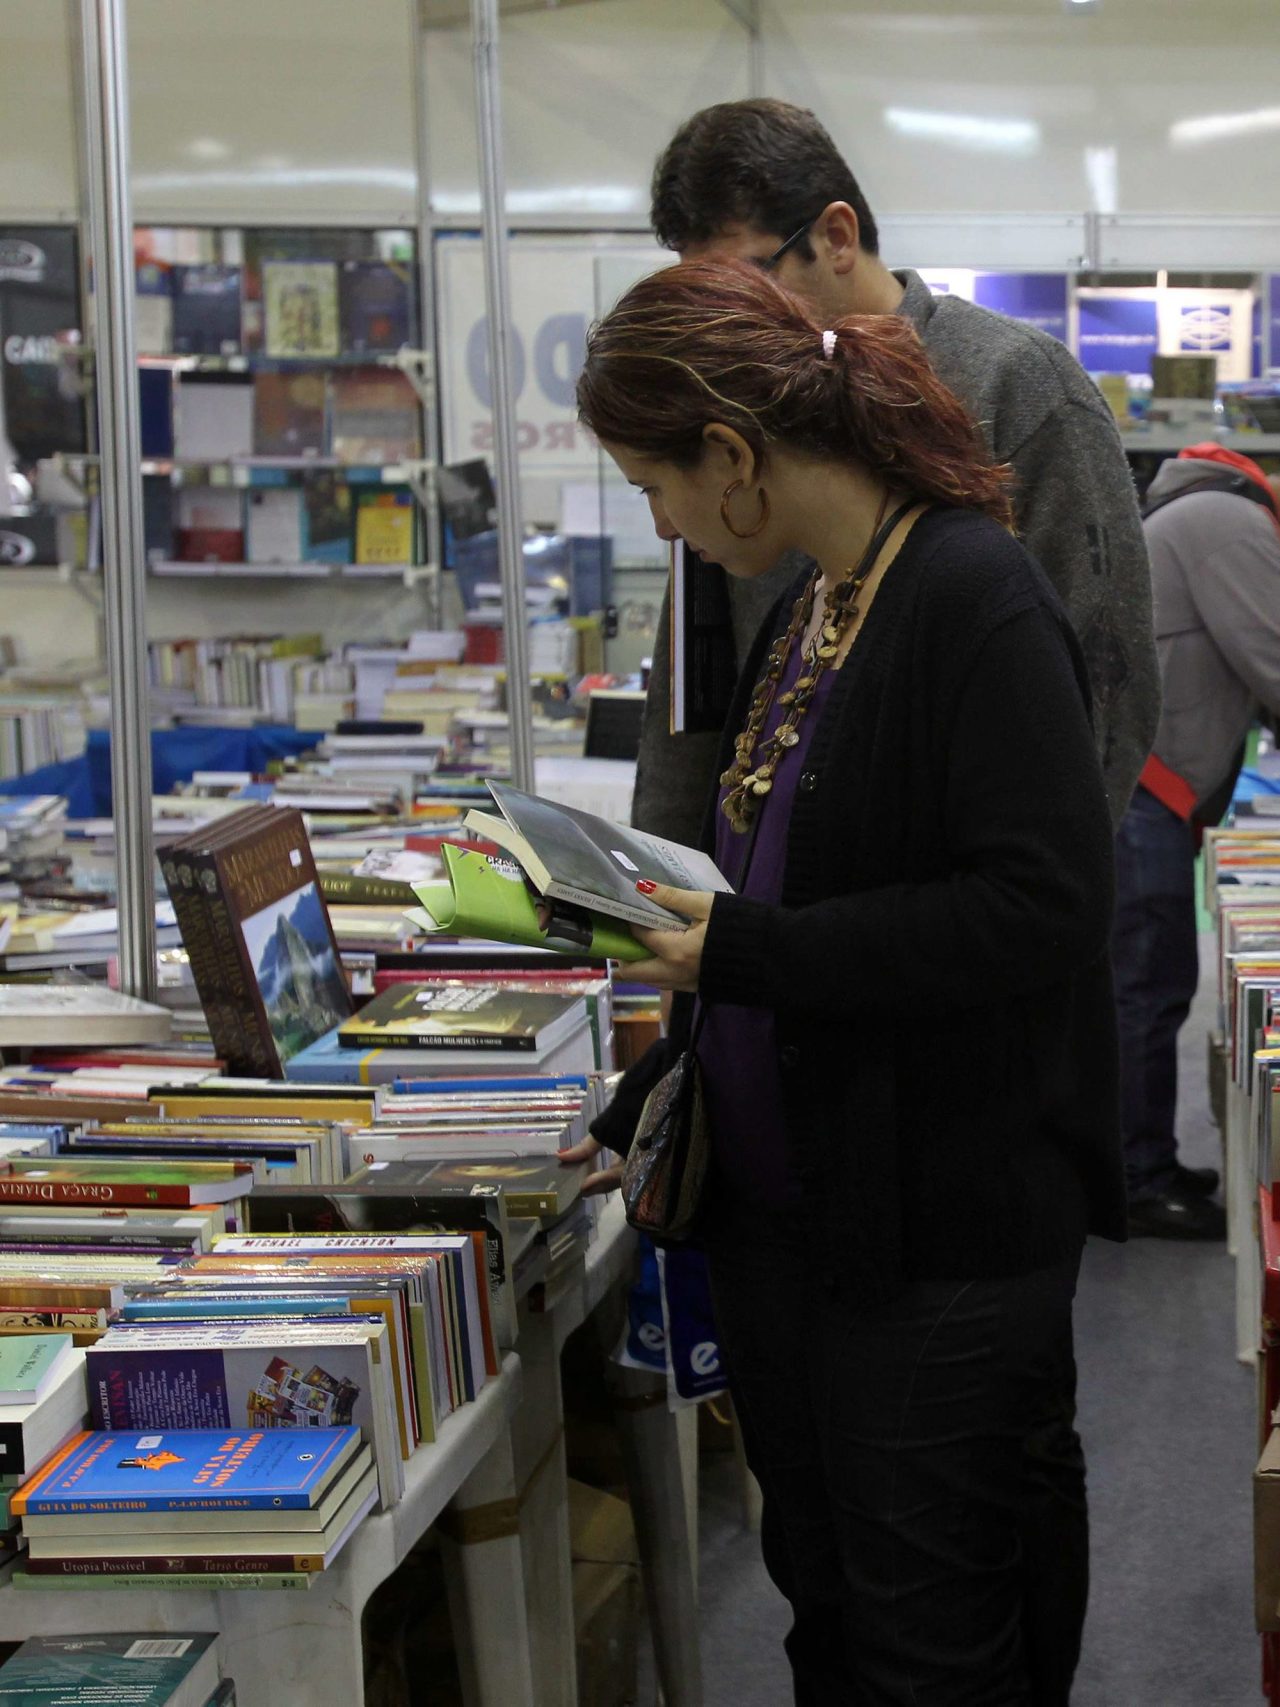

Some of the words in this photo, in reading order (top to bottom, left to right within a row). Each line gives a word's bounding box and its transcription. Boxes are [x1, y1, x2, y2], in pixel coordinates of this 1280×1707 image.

[444, 1036, 476, 1045] MULHERES
[0, 1183, 54, 1200] DIÁRIA
[62, 1183, 114, 1201] GRAÇA
[240, 1238, 302, 1249] MICHAEL
[324, 1236, 398, 1248] CRICHTON
[487, 1239, 501, 1268] Elias
[690, 1340, 720, 1376] e
[99, 1380, 111, 1420] ESCRITOR
[193, 1453, 226, 1485] GUIA
[225, 1436, 243, 1453] DO
[209, 1433, 266, 1490] SOLTEIRO
[38, 1502, 70, 1513] GUIA
[71, 1502, 88, 1512] DO
[89, 1500, 148, 1511] SOLTEIRO
[63, 1561, 100, 1575] Utopia
[101, 1560, 147, 1572] Possível
[202, 1559, 232, 1571] Tarso
[235, 1560, 269, 1571] Genro
